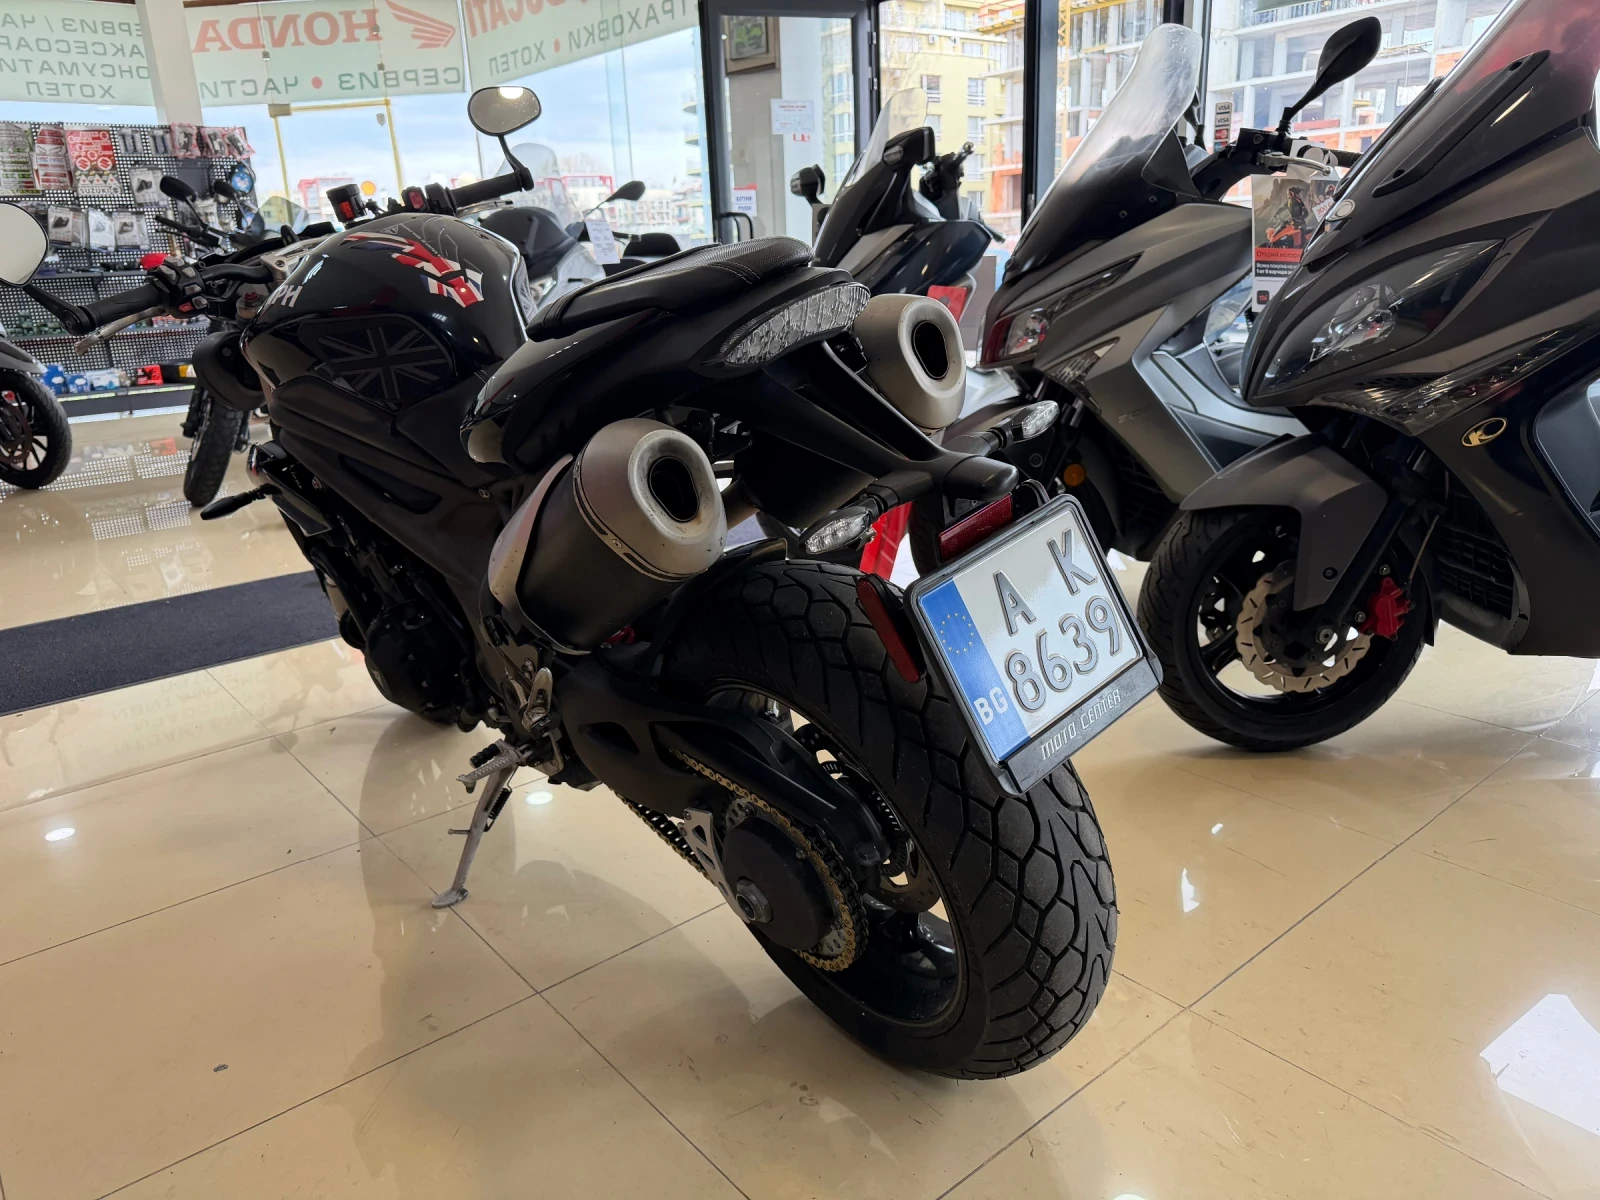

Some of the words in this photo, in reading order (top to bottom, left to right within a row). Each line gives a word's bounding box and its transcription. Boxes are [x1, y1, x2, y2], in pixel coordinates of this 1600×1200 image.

[993, 569, 1037, 637] A
[1046, 527, 1098, 596] K
[1004, 595, 1123, 714] 8639
[973, 686, 1009, 726] BG
[1040, 722, 1078, 762] MOTO
[1080, 688, 1122, 732] CENTER
